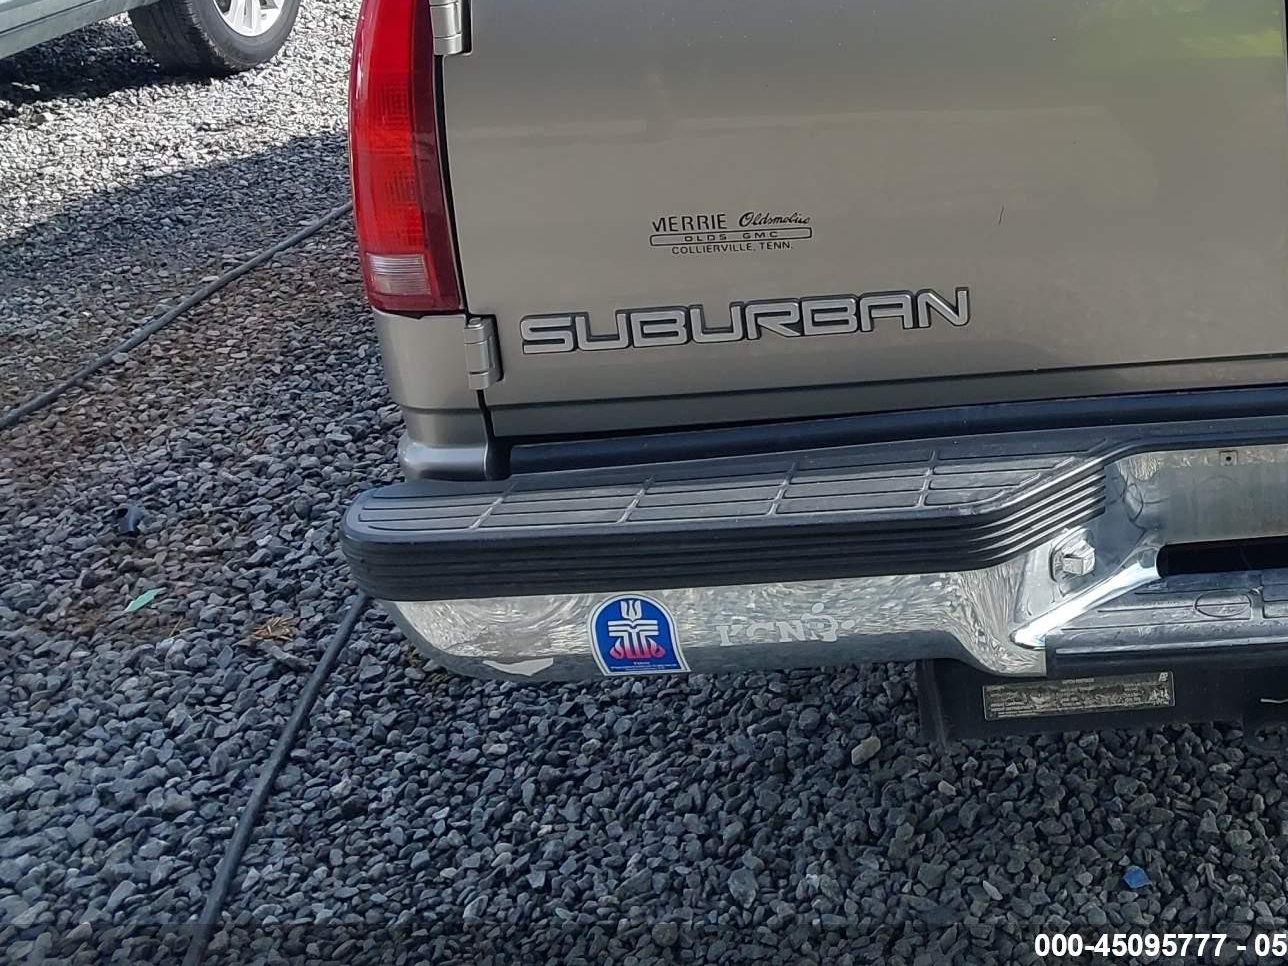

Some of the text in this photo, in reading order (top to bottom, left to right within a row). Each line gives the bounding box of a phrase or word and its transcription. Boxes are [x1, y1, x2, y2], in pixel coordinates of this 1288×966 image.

[684, 231, 779, 242] OLDS GMC
[759, 241, 793, 251] TENN.
[519, 286, 970, 355] SUBURBAN
